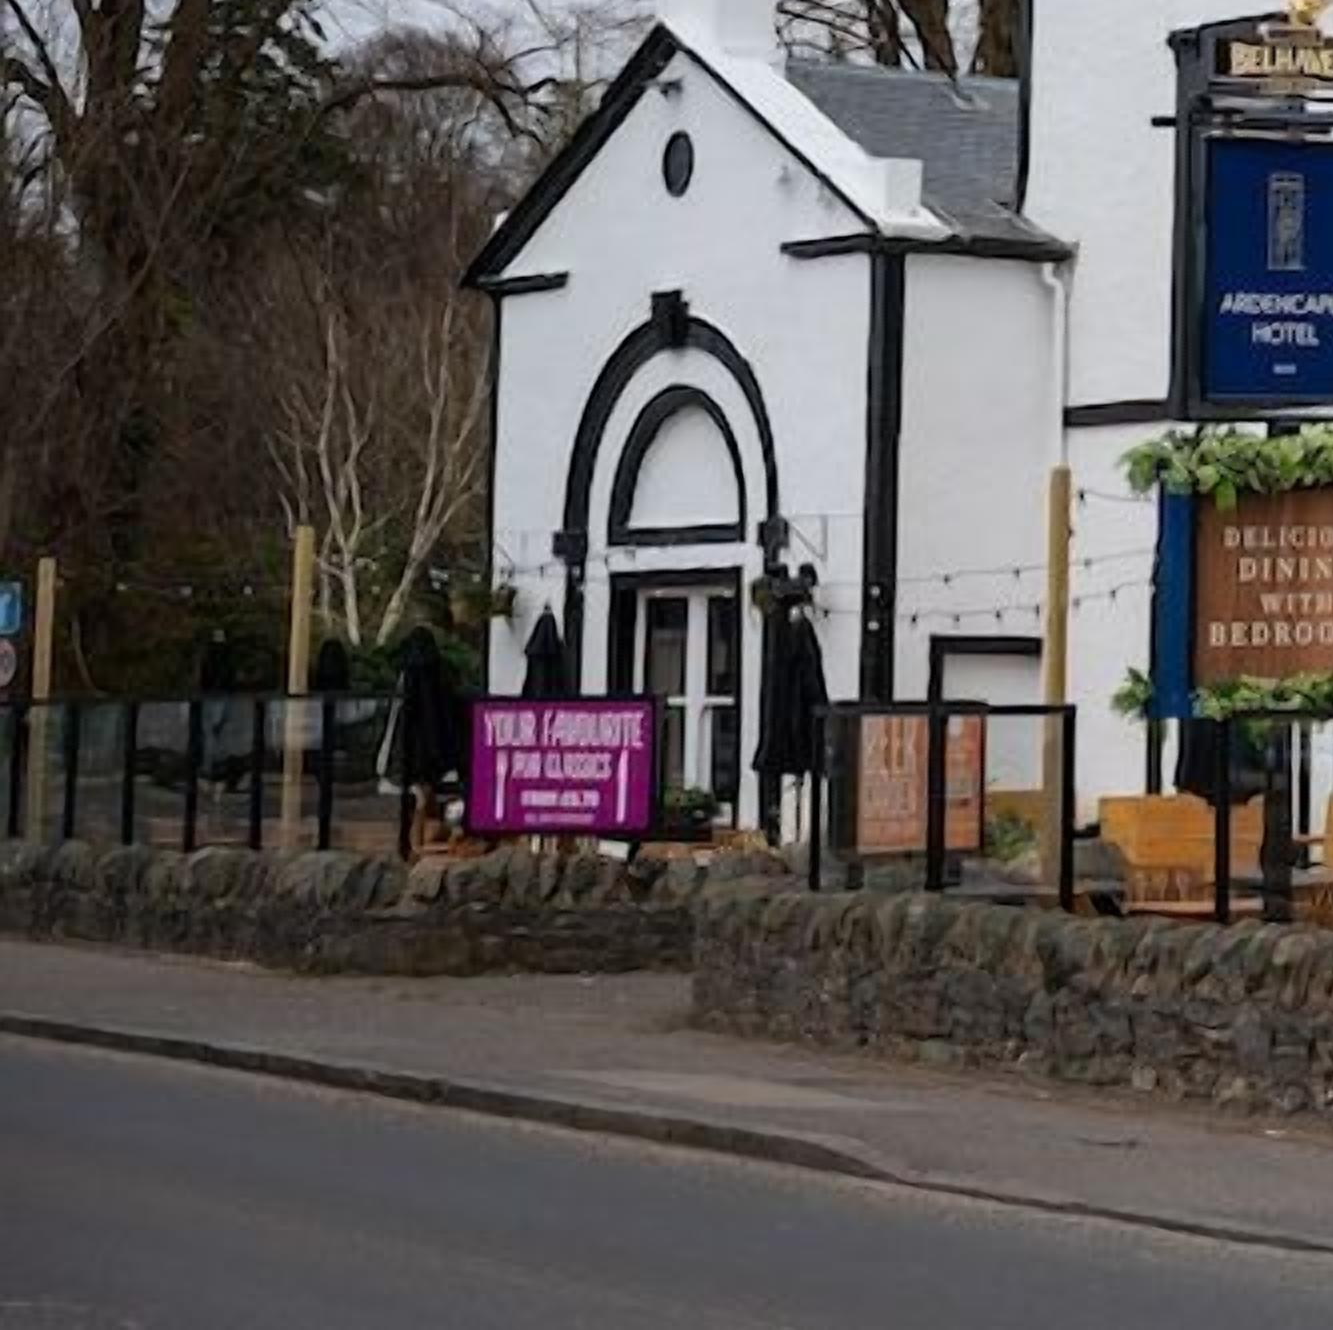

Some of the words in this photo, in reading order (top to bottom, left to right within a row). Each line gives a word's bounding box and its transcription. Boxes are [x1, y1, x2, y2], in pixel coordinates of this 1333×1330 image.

[1252, 322, 1319, 347] HOTEL
[1260, 592, 1333, 615] WITH
[484, 710, 536, 747] YOUR
